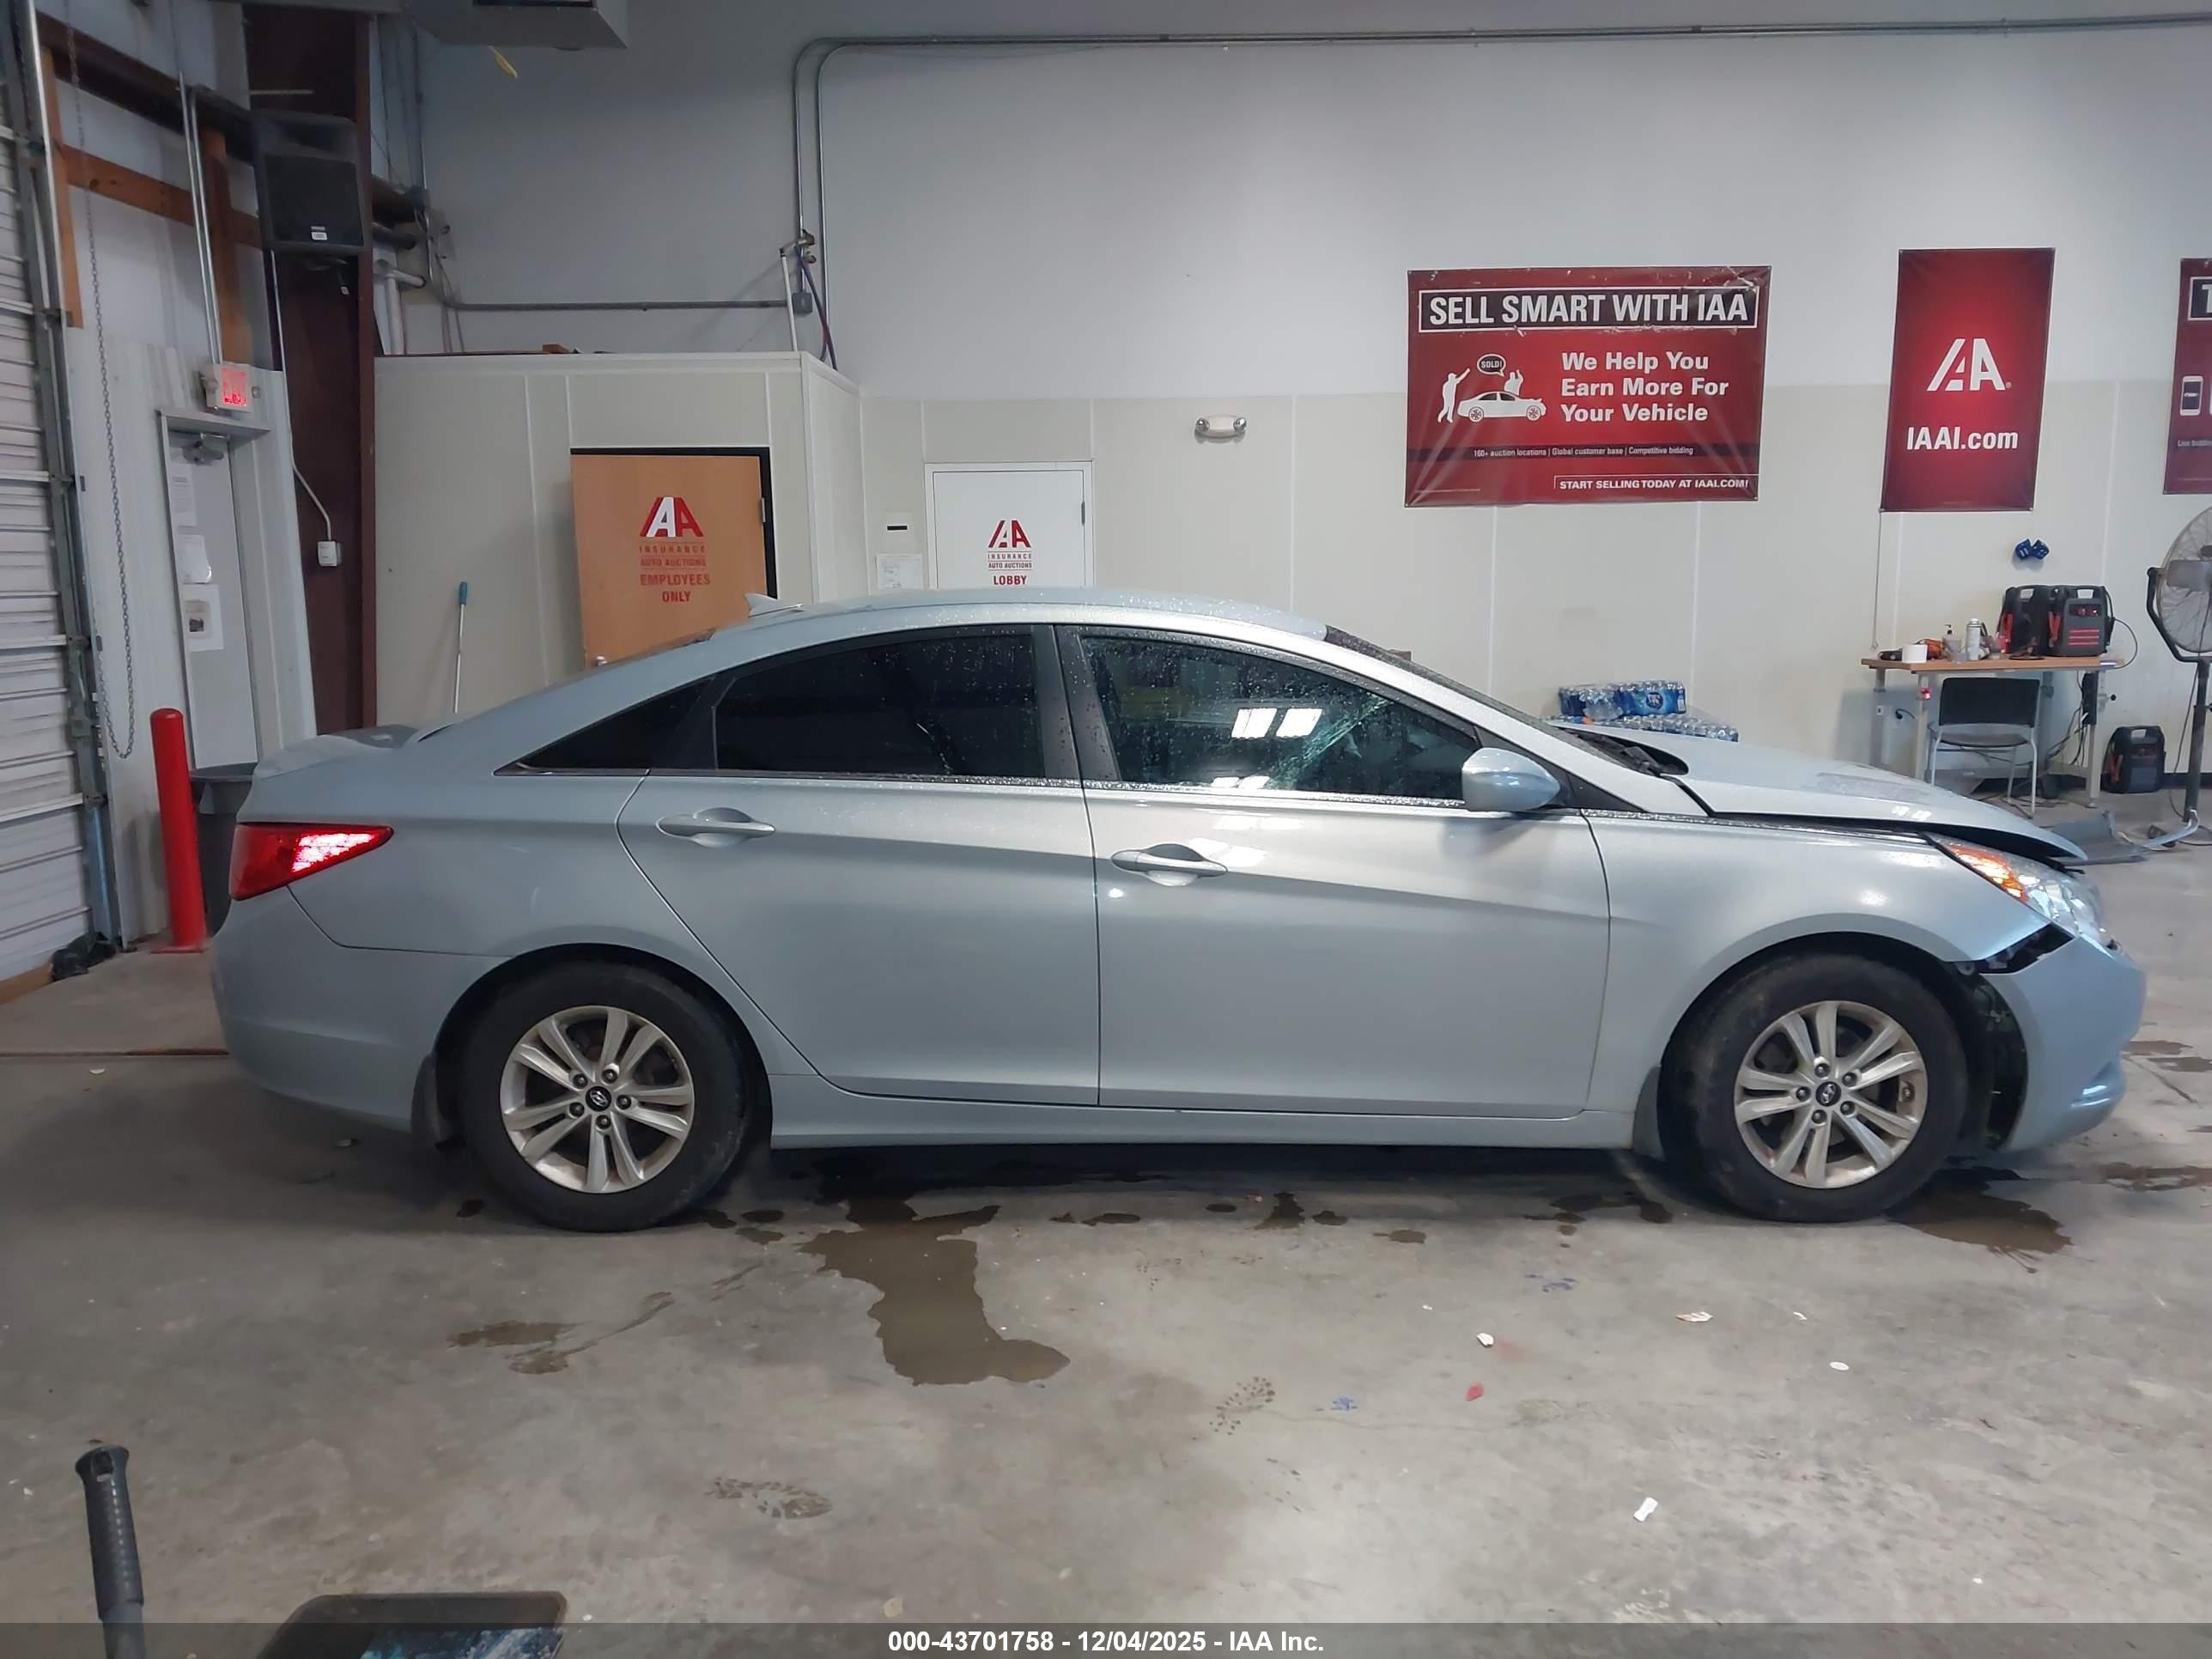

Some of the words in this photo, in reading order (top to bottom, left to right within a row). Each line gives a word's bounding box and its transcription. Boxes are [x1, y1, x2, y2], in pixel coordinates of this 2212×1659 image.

[1430, 296, 1494, 325] SELL
[1502, 294, 1606, 323] SMART
[1613, 293, 1689, 321] WITH
[1697, 293, 1748, 321] IAA
[1481, 360, 1503, 368] SOLD!
[1561, 352, 1597, 371] We
[1605, 351, 1659, 374] Help
[1666, 350, 1709, 370] You
[1561, 378, 1614, 397] Earn
[1622, 377, 1683, 396] More
[1691, 377, 1729, 396] For
[1560, 404, 1614, 422] Your
[1622, 403, 1708, 422] Vehicle
[1906, 426, 2019, 451] IAAI.com
[1516, 448, 1547, 457] locations
[1607, 447, 1624, 455] base
[1628, 447, 1668, 455] Competitive
[1668, 446, 1694, 456] bidding
[1559, 480, 1594, 489] START
[1595, 480, 1639, 489] SELLING
[1641, 479, 1677, 489] TODAY
[1678, 479, 1692, 489] AT
[639, 544, 706, 554] INSURANCE
[640, 558, 662, 567] AUTO
[665, 558, 707, 567] AUCTIONS
[640, 574, 711, 586] EMPLOYEES
[993, 574, 1027, 586] LOBBY
[662, 590, 691, 603] ONLY
